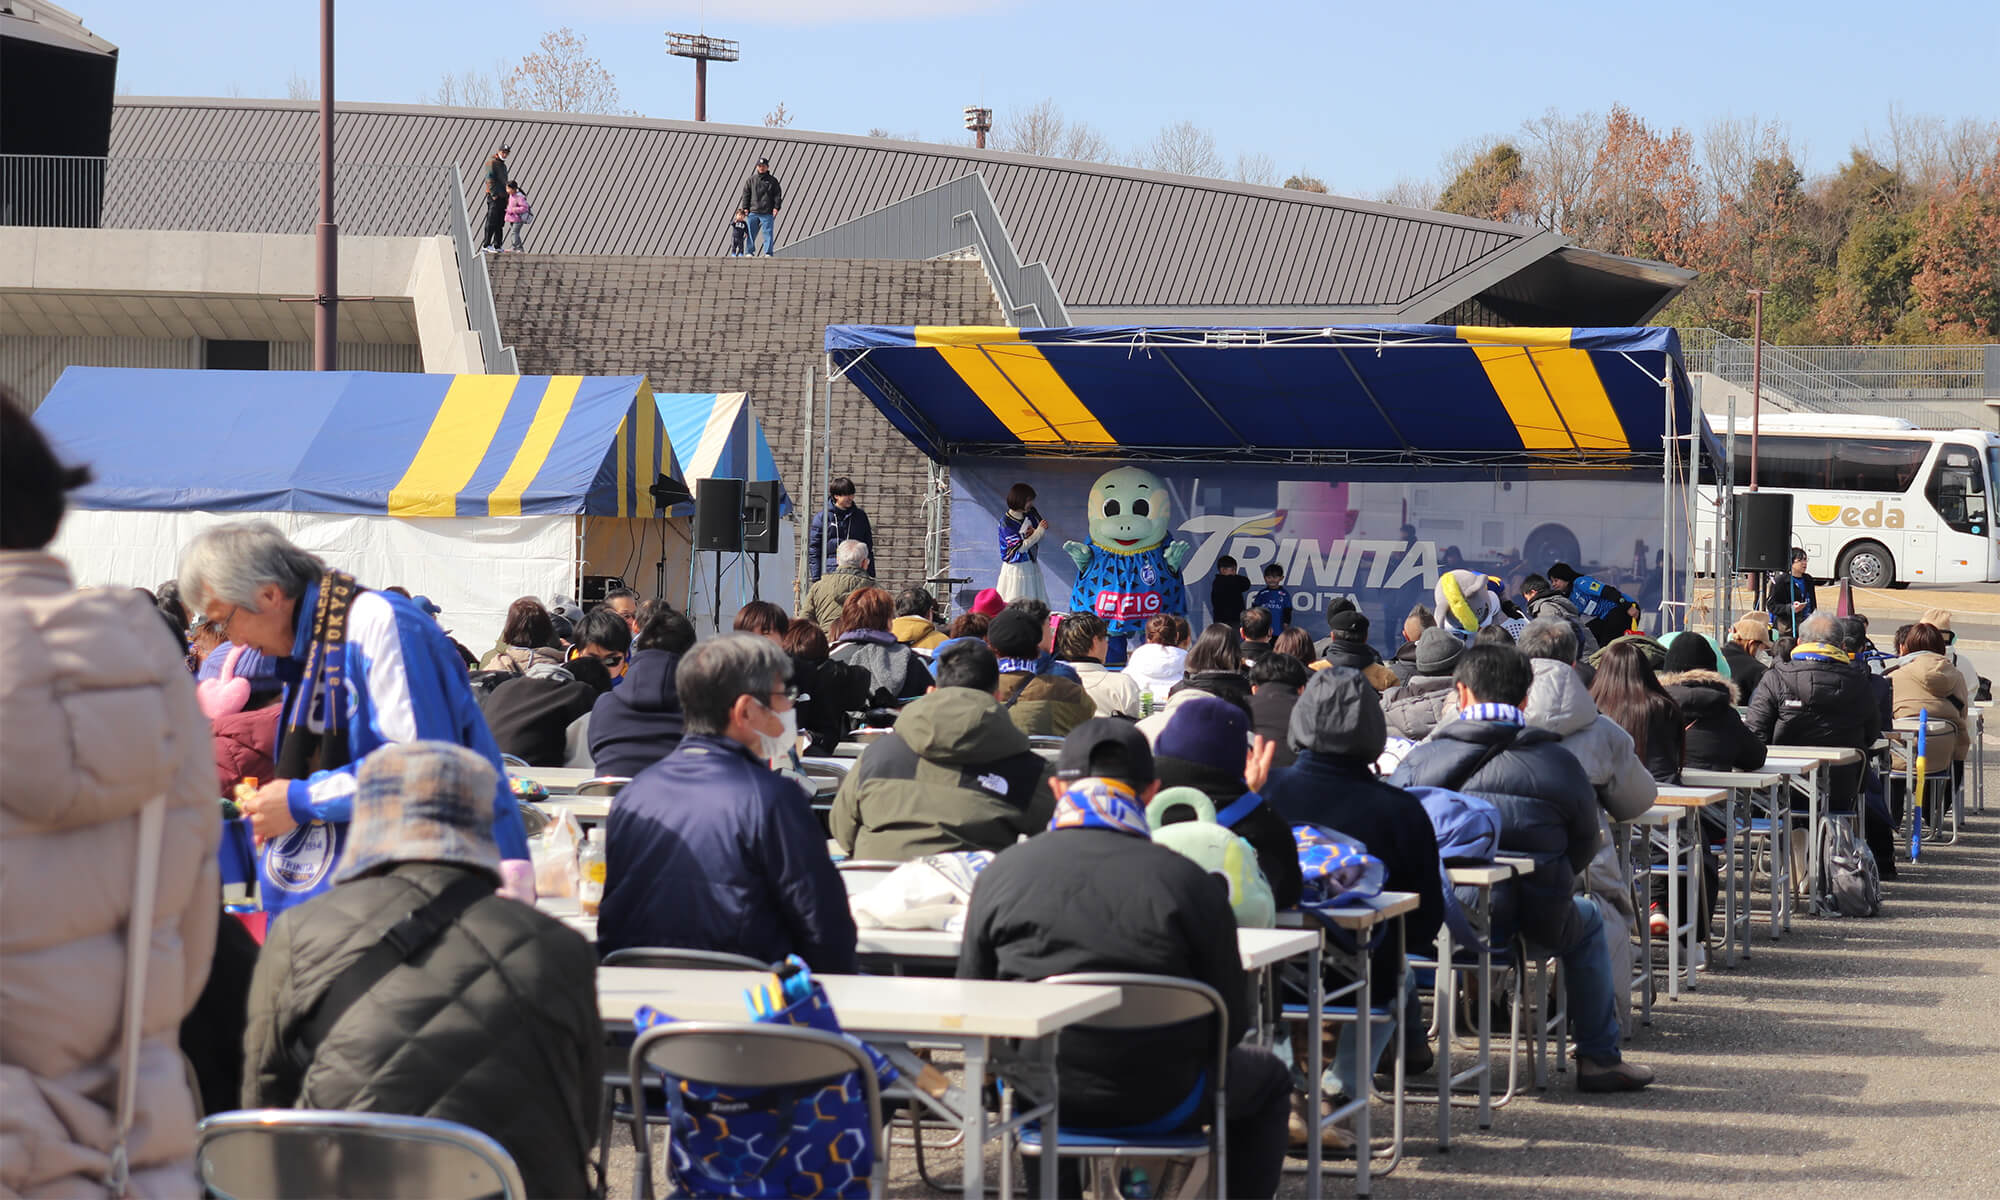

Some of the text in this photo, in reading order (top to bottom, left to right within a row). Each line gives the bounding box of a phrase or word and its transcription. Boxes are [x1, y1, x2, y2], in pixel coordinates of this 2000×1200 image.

[1177, 511, 1445, 589] TRINITA
[326, 586, 350, 655] TOKYO
[1121, 593, 1160, 613] FIG
